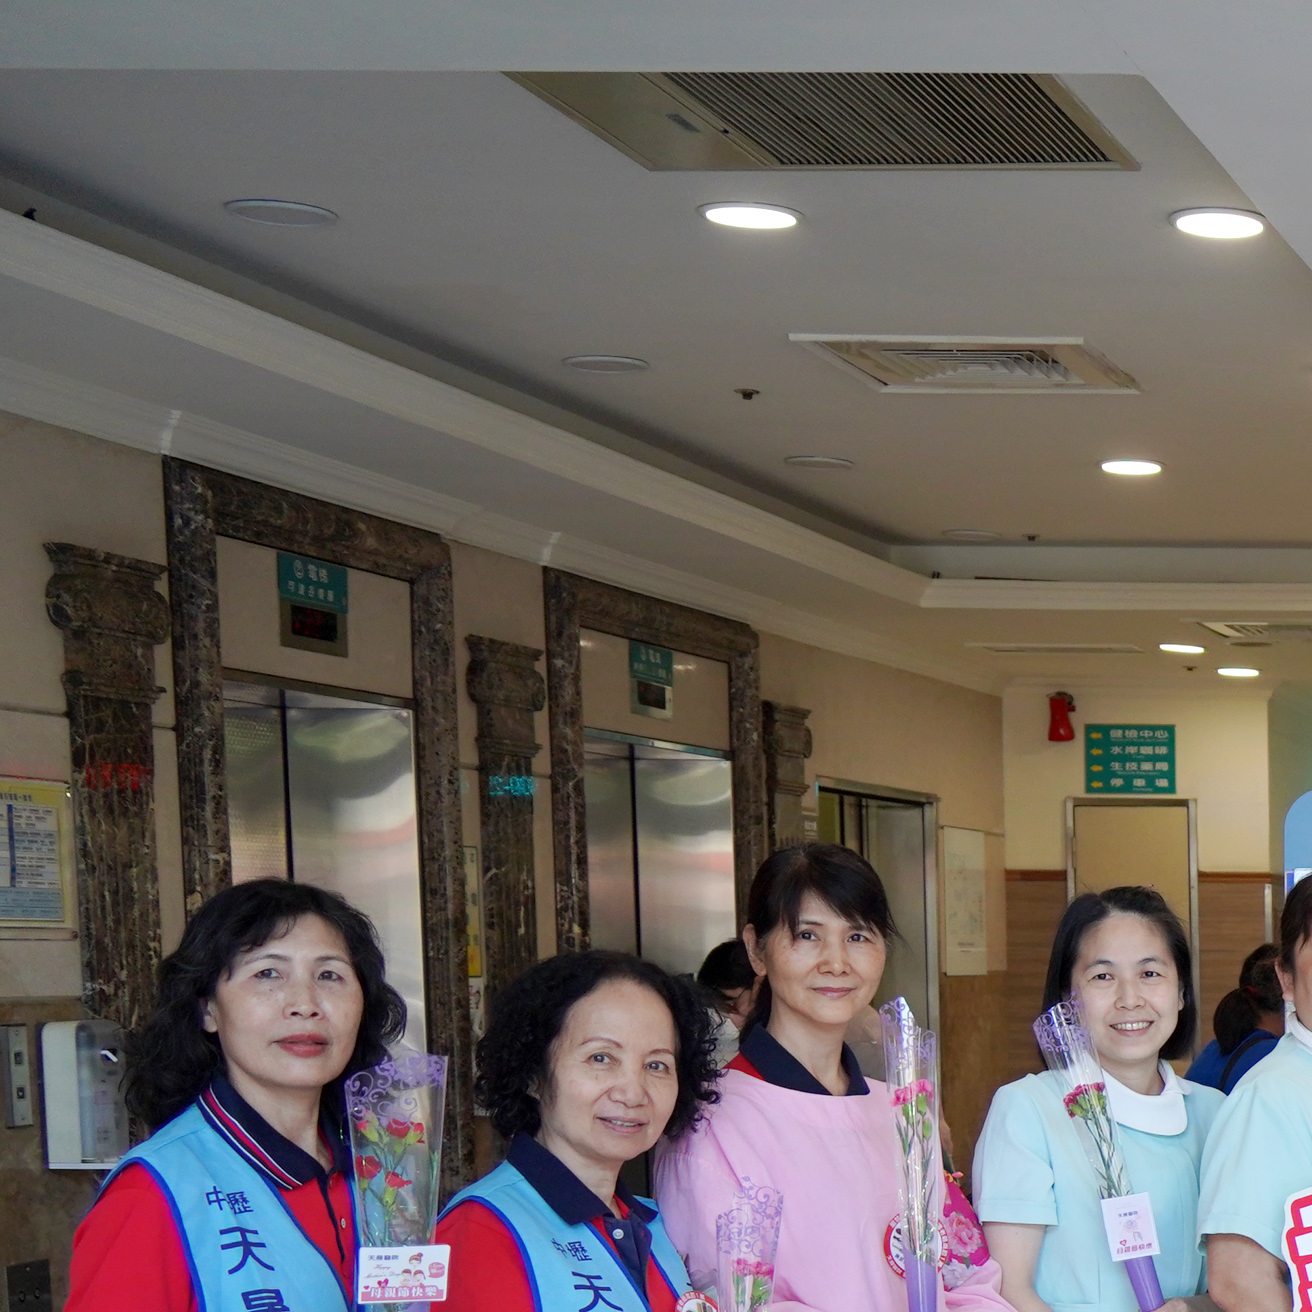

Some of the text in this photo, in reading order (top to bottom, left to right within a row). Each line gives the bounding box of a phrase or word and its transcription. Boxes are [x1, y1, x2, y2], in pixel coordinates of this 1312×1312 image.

[370, 1286, 438, 1299] 母親節快樂
